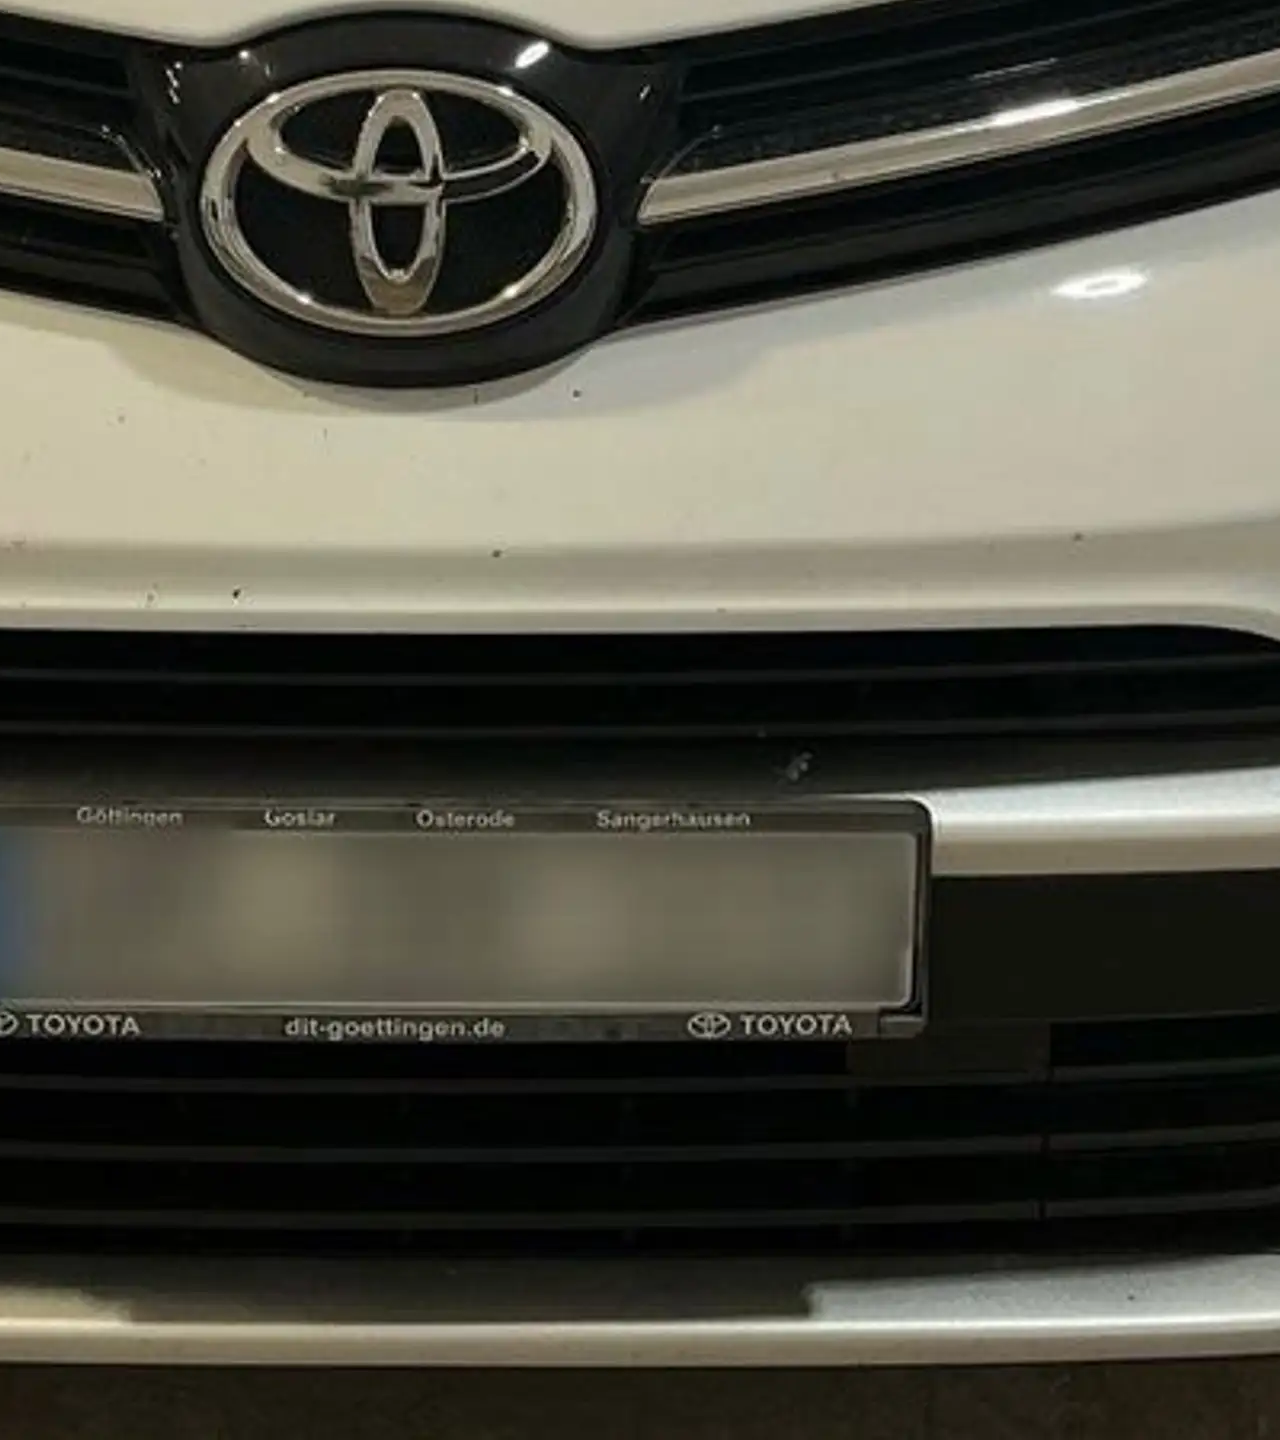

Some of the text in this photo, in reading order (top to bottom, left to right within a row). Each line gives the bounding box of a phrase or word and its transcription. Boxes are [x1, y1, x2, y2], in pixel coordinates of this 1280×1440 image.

[264, 807, 337, 827] Goslar
[415, 809, 516, 829] Osterode
[596, 809, 751, 831] Sangerhausen
[26, 1013, 142, 1036] TOYOTA
[284, 1017, 506, 1042] dit-goettingen.de
[740, 1013, 854, 1036] TOYOTA
